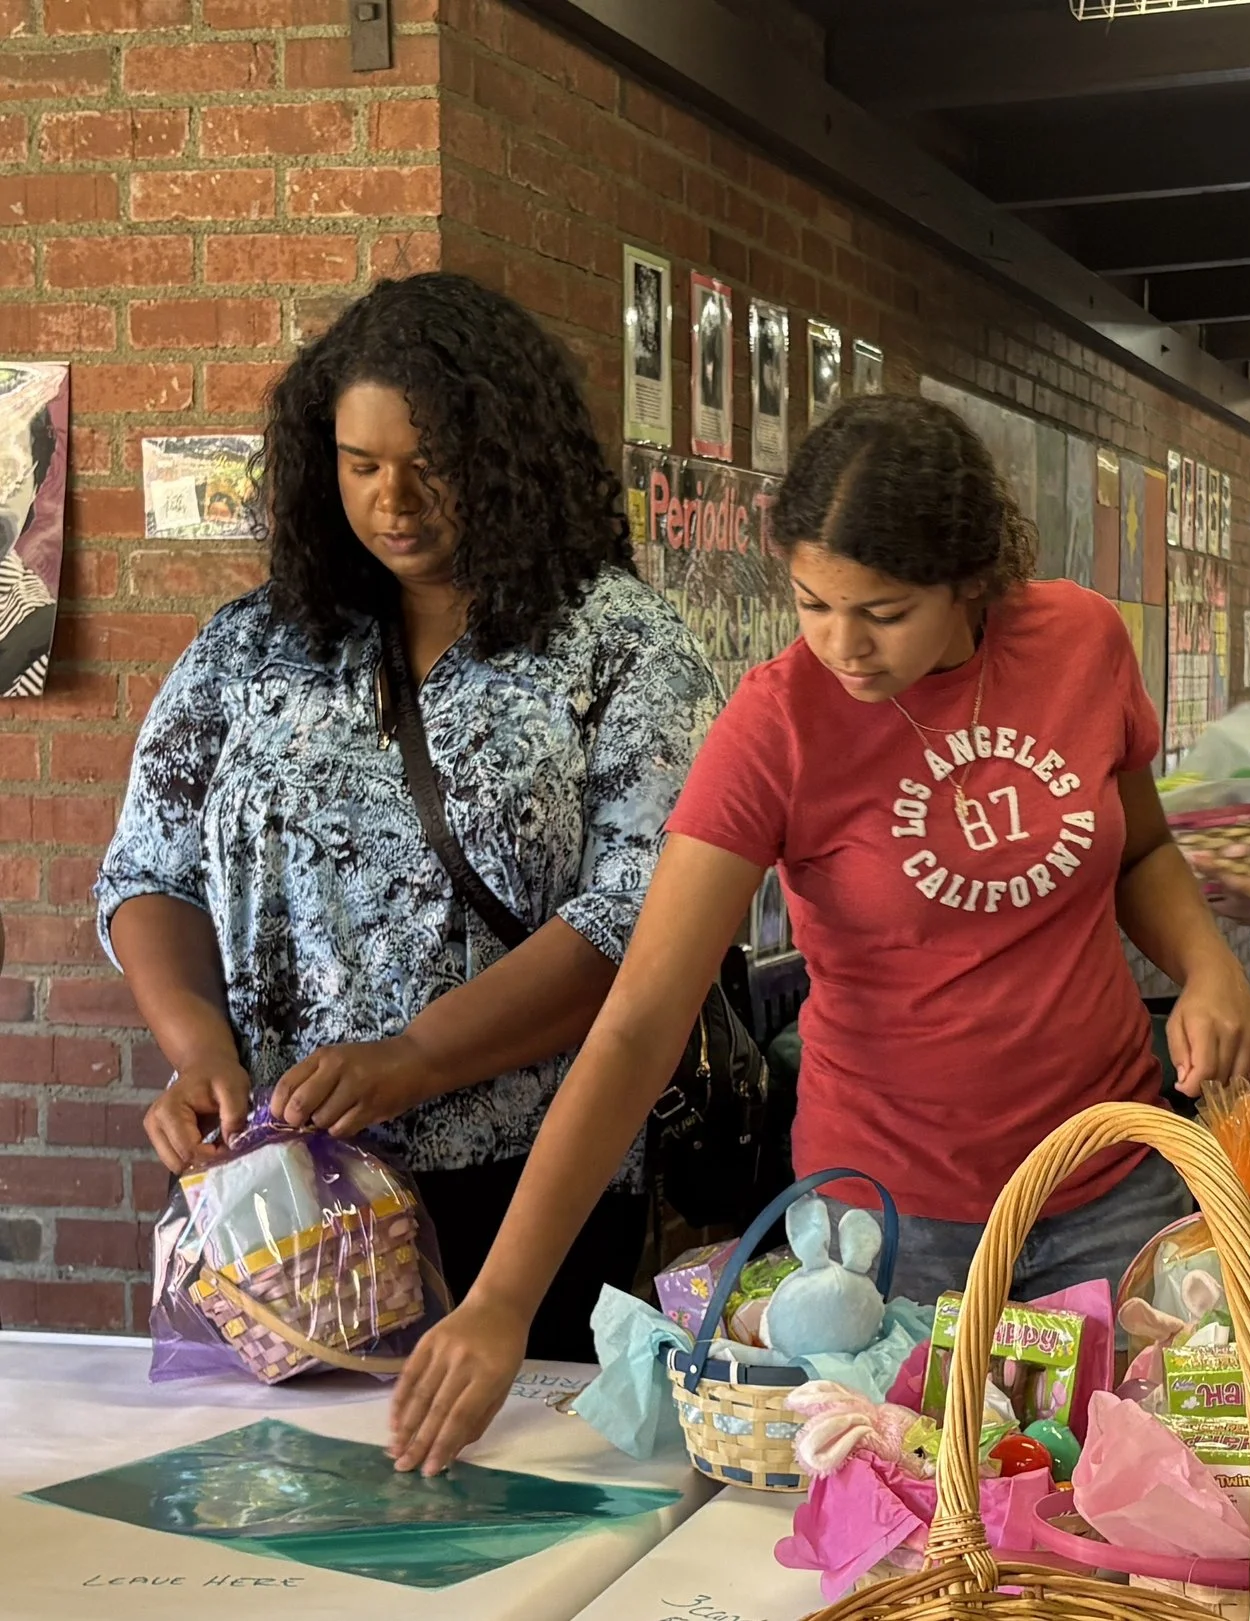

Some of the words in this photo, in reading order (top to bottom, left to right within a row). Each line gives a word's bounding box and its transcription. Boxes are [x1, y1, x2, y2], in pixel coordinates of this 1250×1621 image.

[650, 468, 749, 555] Periodic
[736, 594, 800, 661] Histo
[891, 777, 932, 838] LOS
[923, 725, 1081, 797] ANGELES
[901, 809, 1096, 913] CALIFORNIA
[995, 1320, 1059, 1353] ppy
[1195, 1382, 1246, 1408] Ha
[82, 1574, 186, 1587] LEAVE
[203, 1574, 305, 1588] HERE
